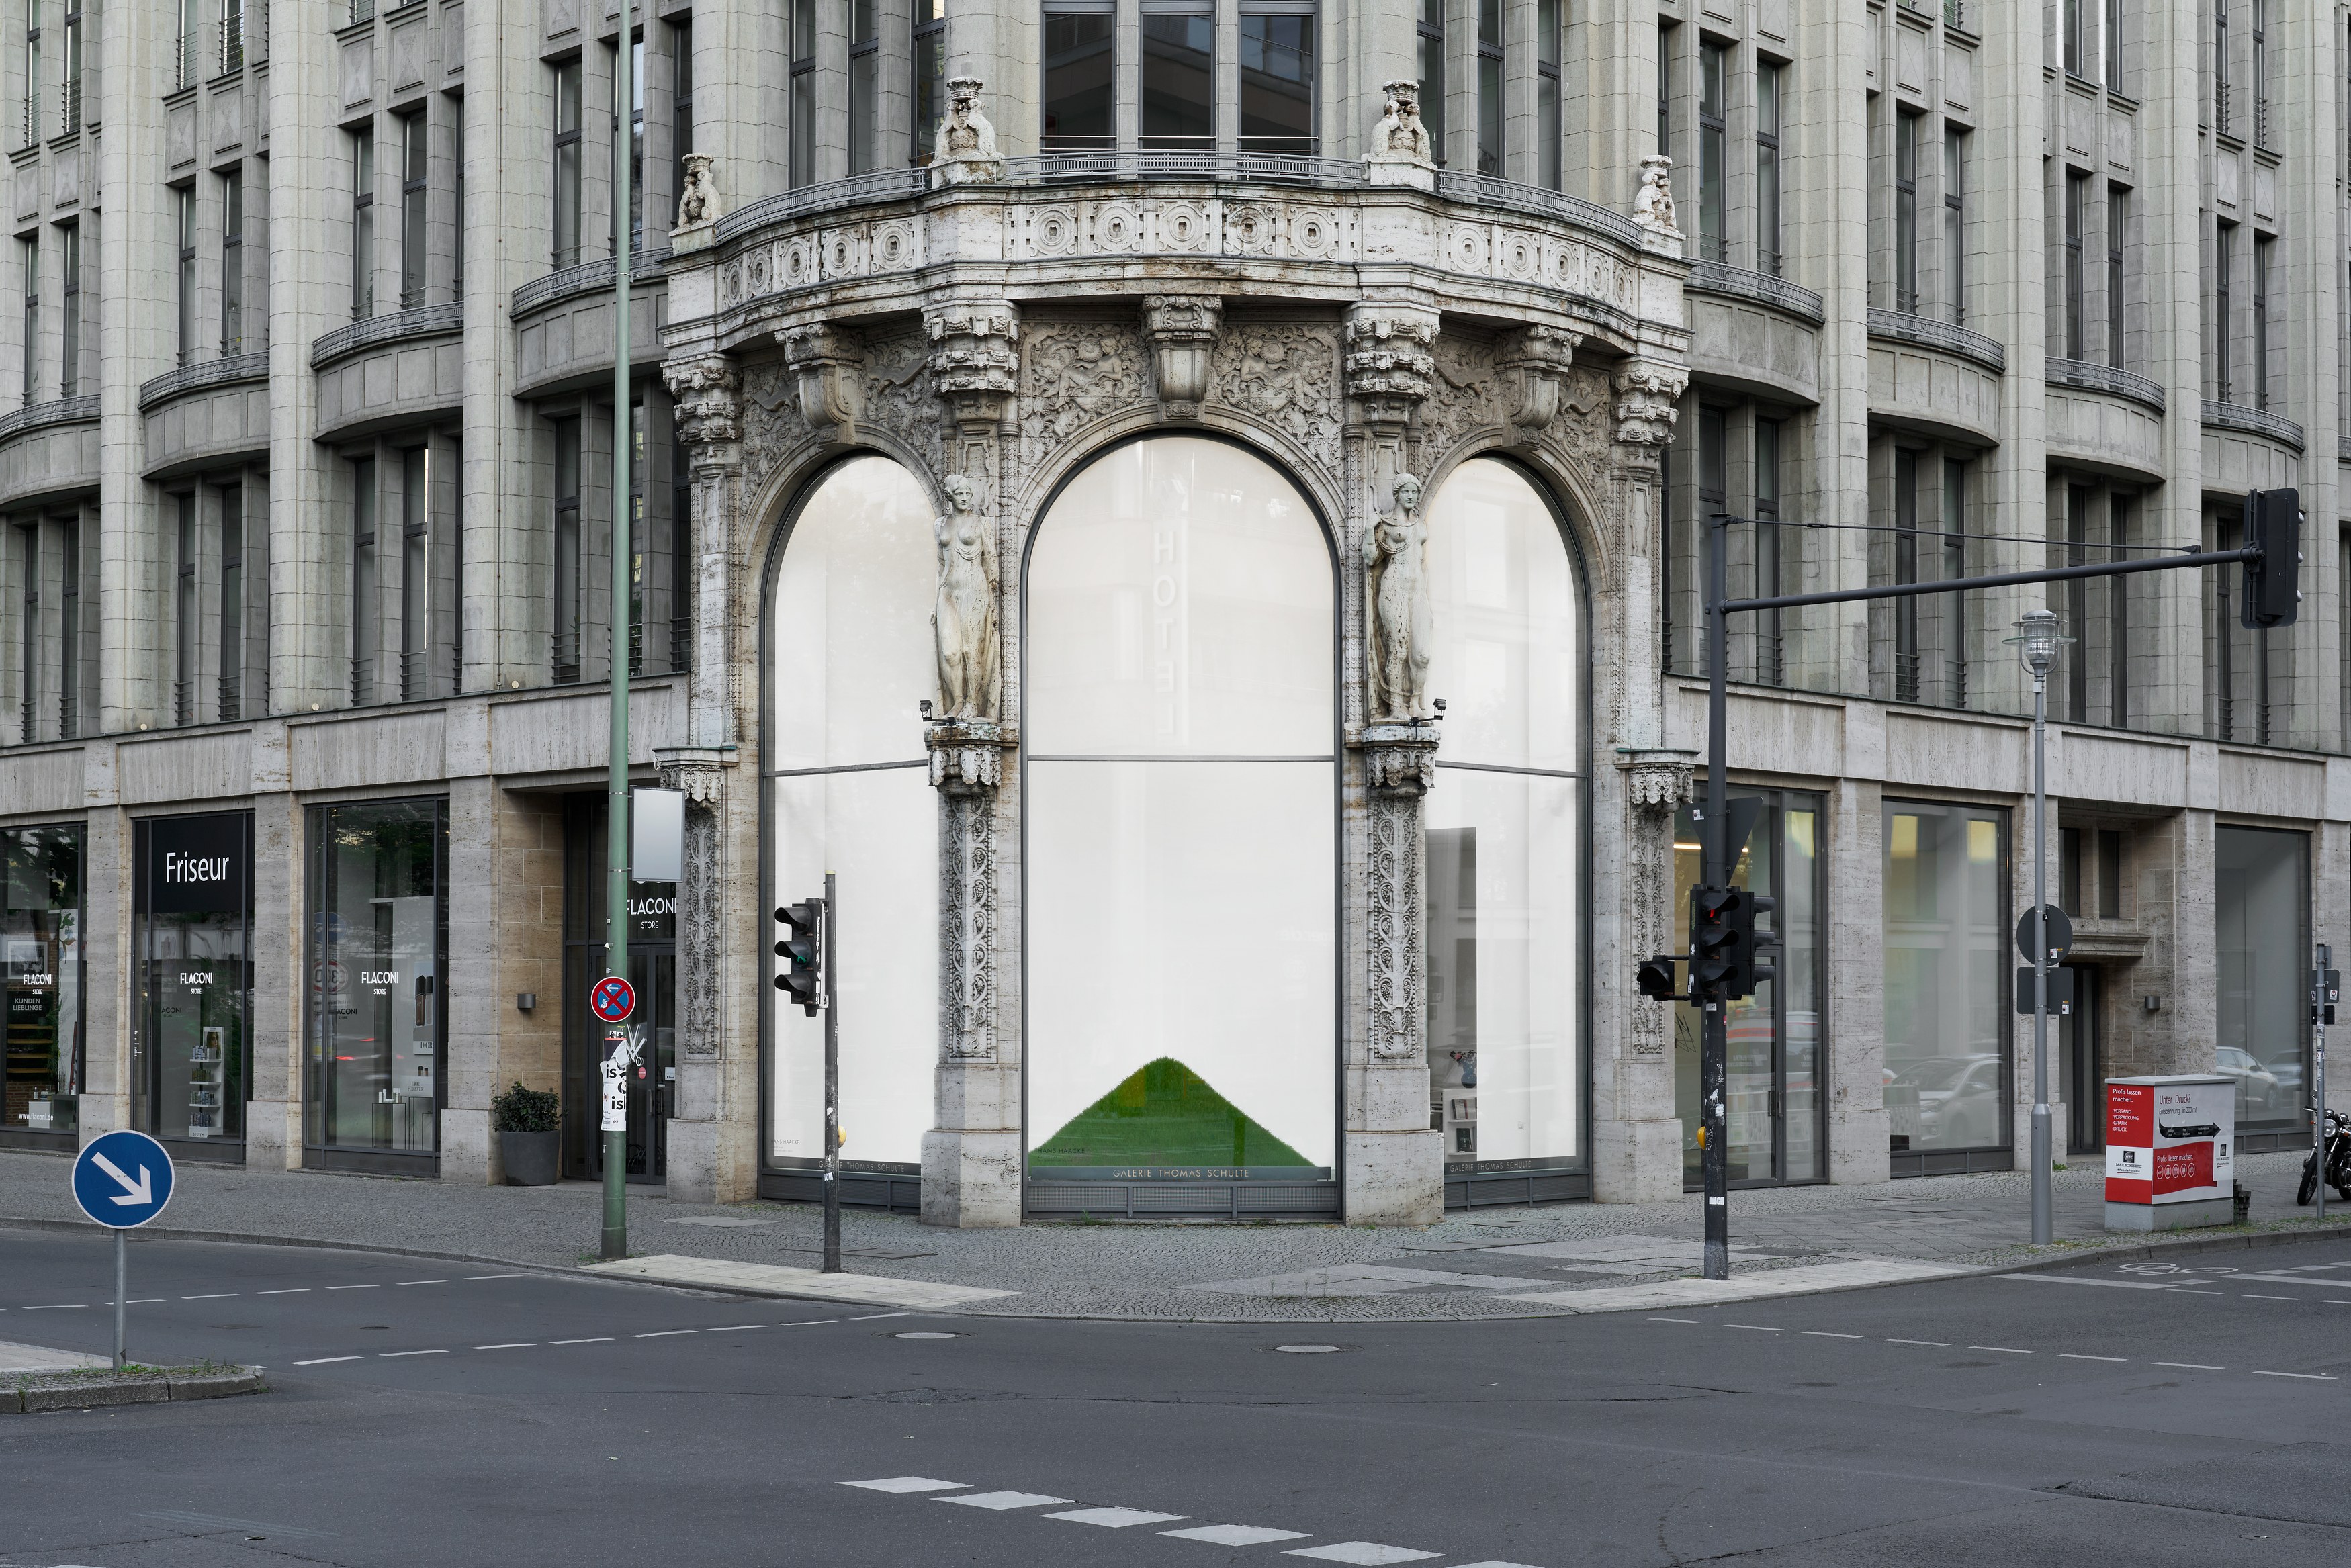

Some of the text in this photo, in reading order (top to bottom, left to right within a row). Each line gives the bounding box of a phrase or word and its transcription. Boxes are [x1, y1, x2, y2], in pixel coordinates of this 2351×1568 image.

[166, 851, 230, 883] Friseur
[641, 921, 658, 929] STORE
[23, 974, 52, 985] FLACONI
[180, 972, 212, 984] FLACONI
[361, 971, 399, 984] FLACONI
[2159, 1094, 2191, 1105] Unter Druck?
[18, 1112, 54, 1121] www.flaconi.de
[2157, 1154, 2167, 1162] Profis
[847, 1162, 874, 1170] THOMAS
[877, 1164, 905, 1172] SCHULTE
[1450, 1160, 1532, 1172] GALERIE THOMAS SCHULTE
[1112, 1169, 1250, 1177] GALERIE THOMAS SCHULTE
